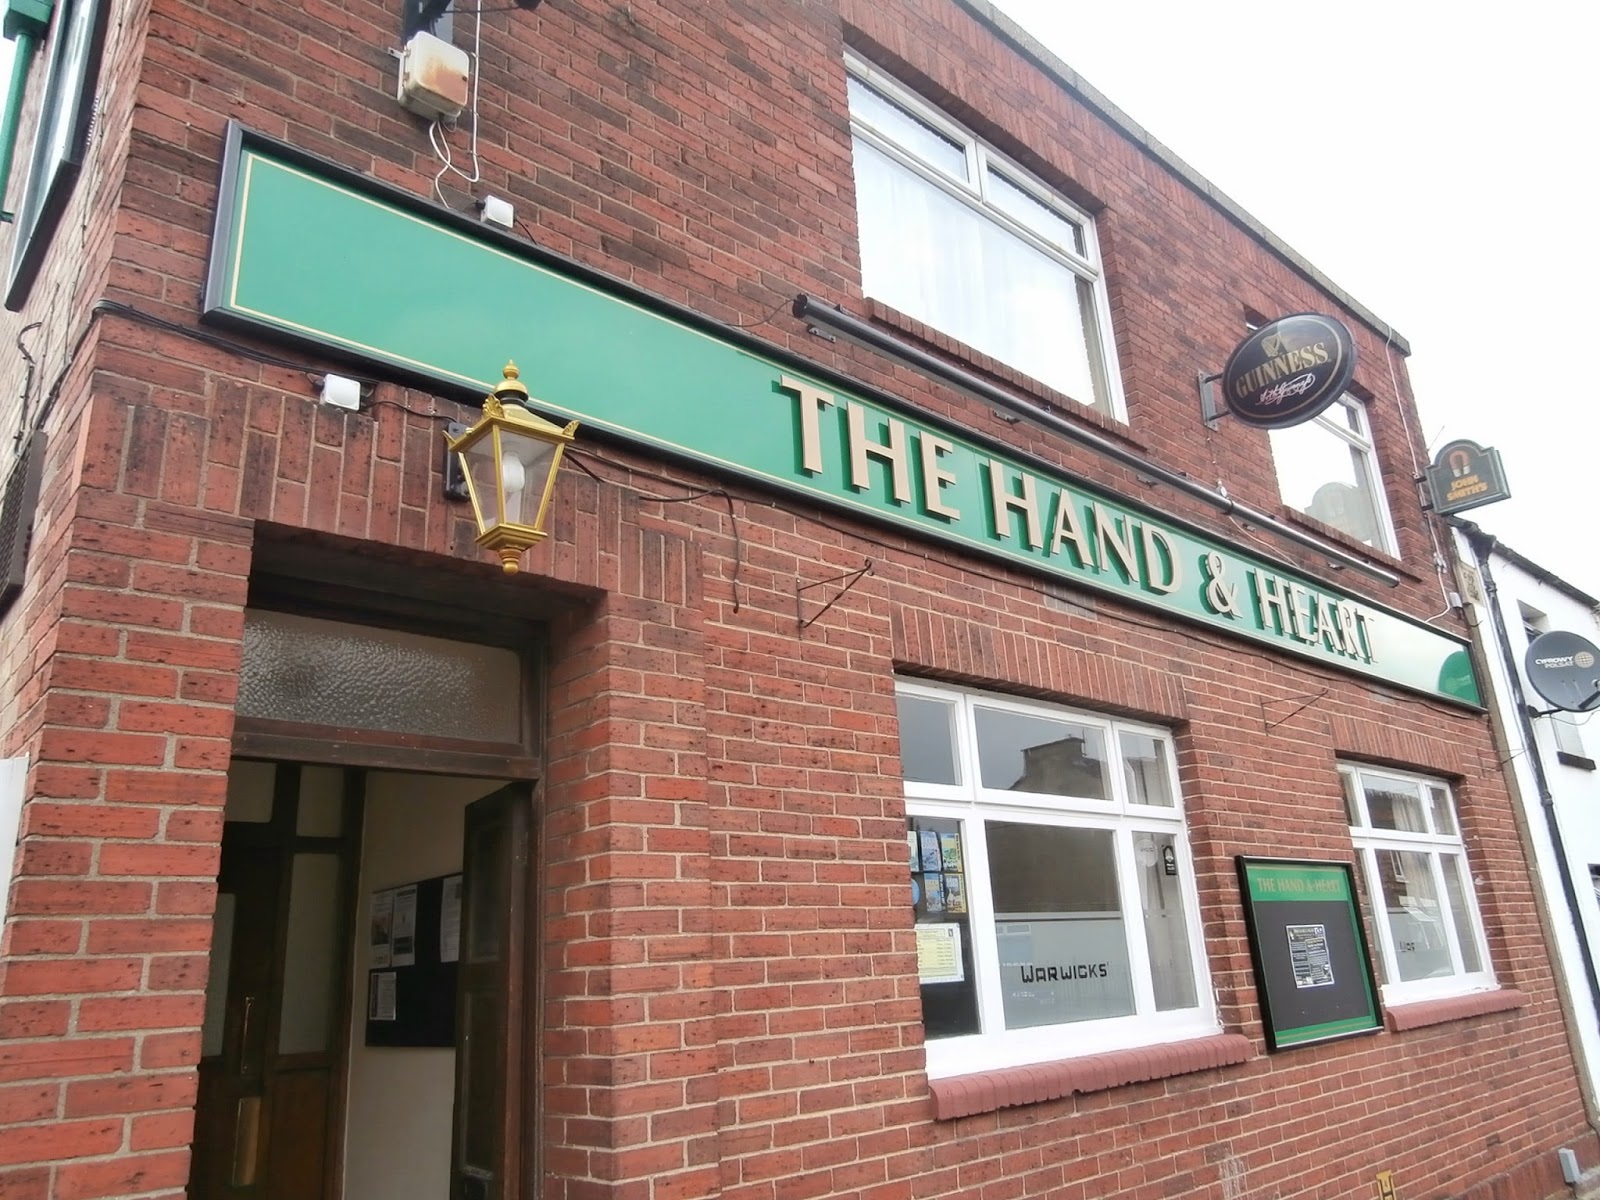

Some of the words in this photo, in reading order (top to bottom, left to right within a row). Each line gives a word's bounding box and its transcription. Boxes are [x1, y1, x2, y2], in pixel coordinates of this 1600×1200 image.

[1235, 342, 1330, 399] GUINNESS
[1450, 474, 1479, 491] JOHN
[775, 374, 961, 522] THE
[983, 458, 1184, 594] HAND
[1202, 550, 1244, 620] &
[1252, 566, 1380, 665] HEART
[1257, 877, 1276, 893] THE
[1277, 878, 1305, 893] HAND
[1314, 879, 1341, 894] HEART
